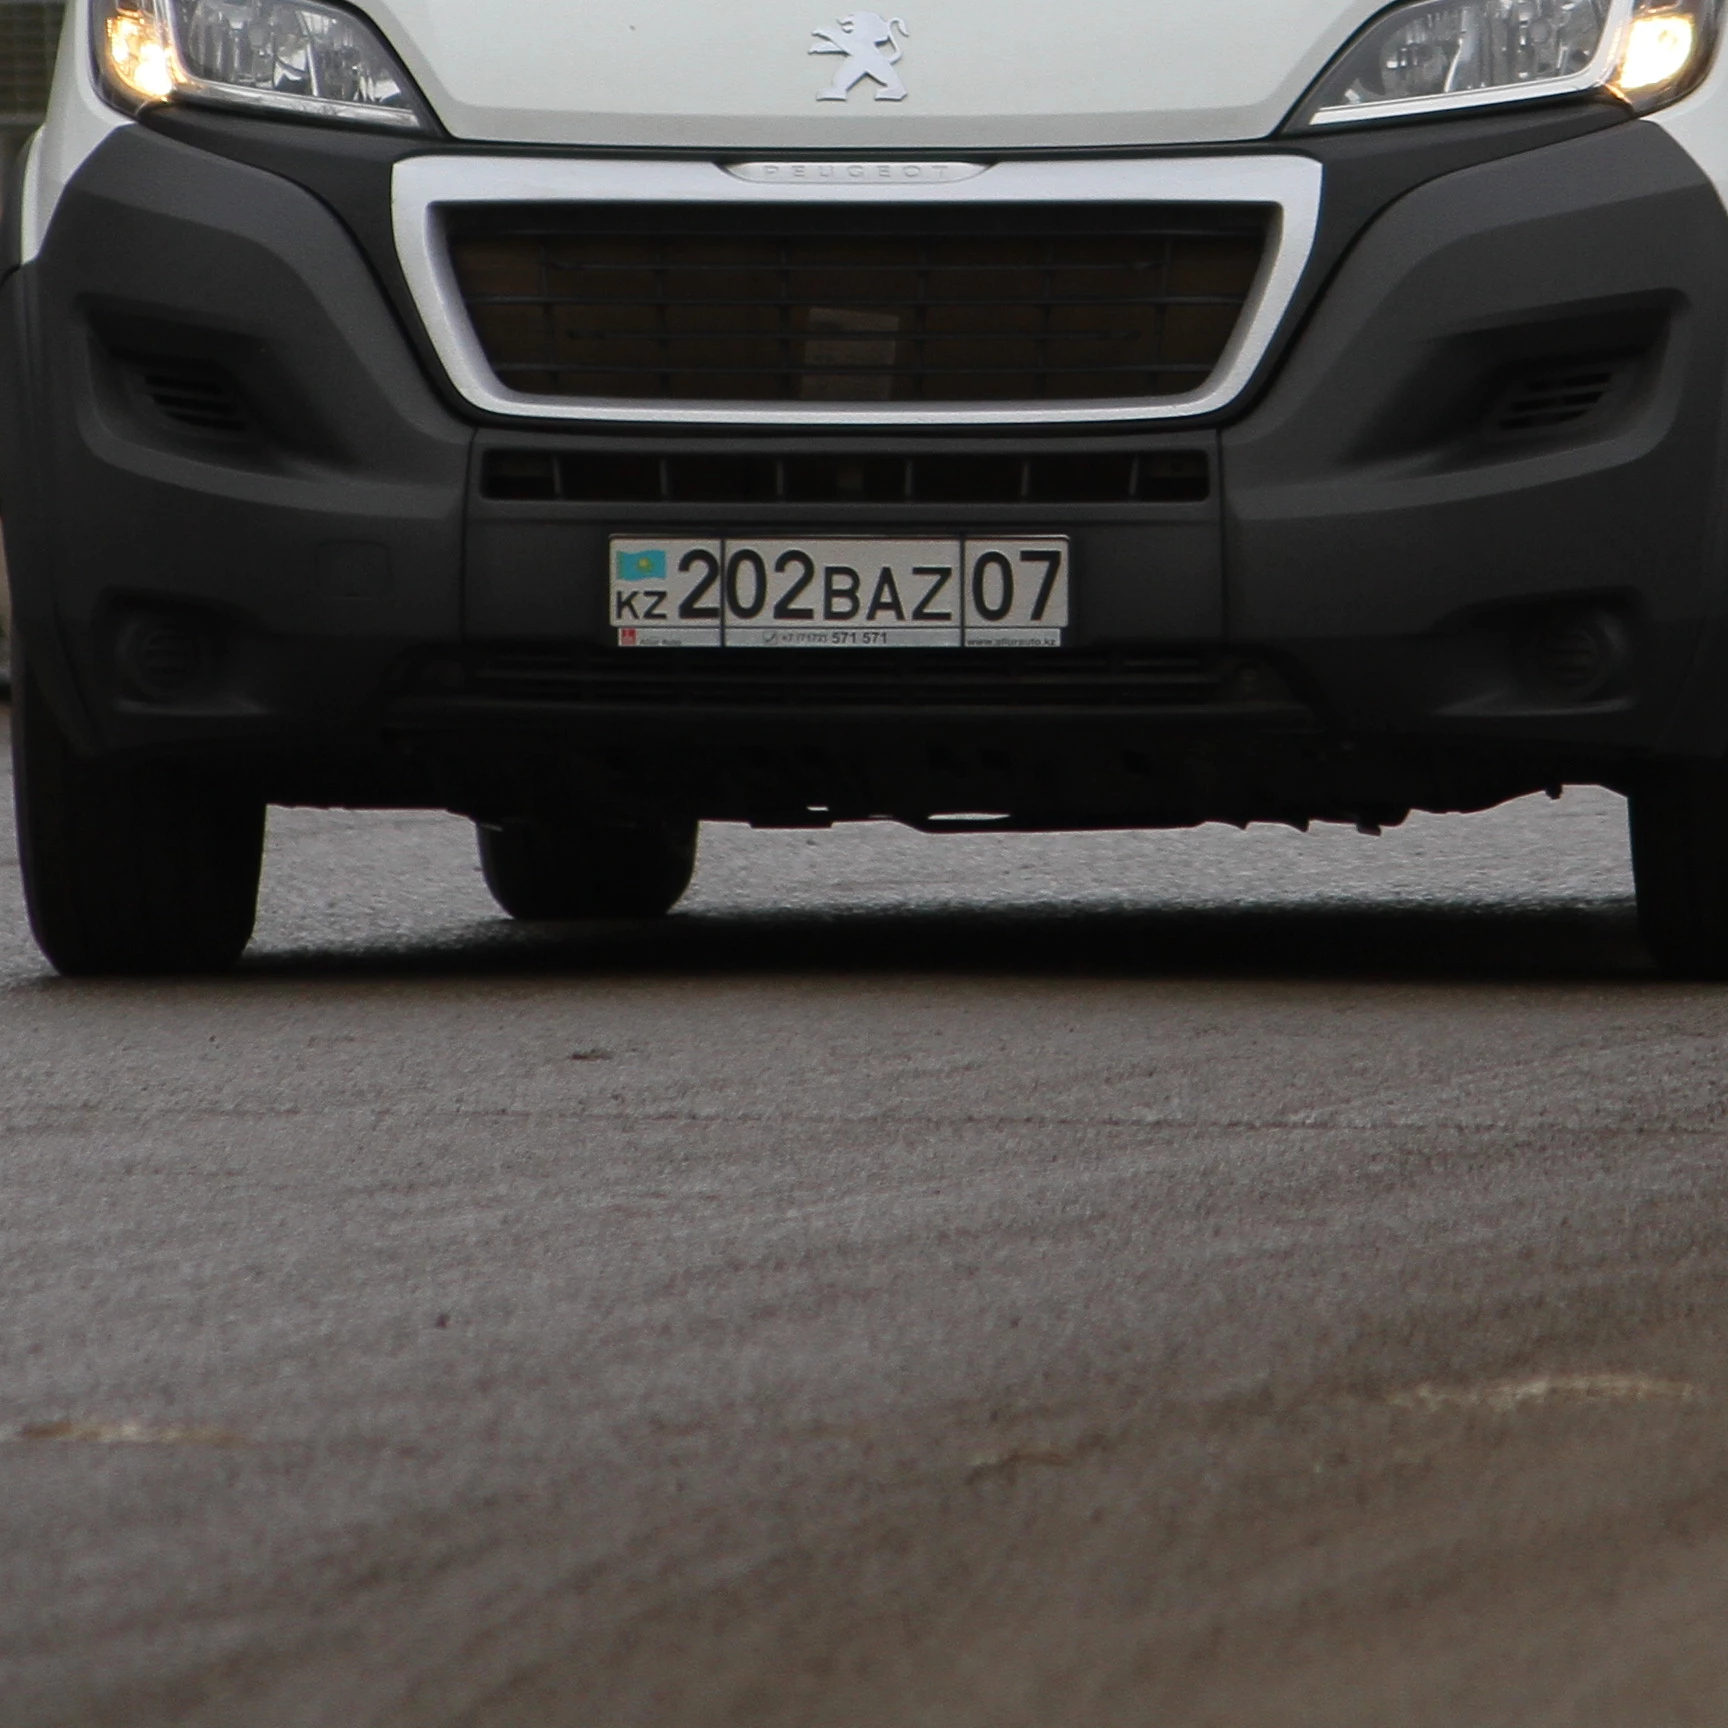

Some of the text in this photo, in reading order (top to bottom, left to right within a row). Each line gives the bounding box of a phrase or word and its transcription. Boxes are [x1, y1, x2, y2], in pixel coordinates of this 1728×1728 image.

[763, 164, 949, 178] PEUGEOT
[615, 548, 1063, 622] KZ 202BAZ 07
[831, 631, 856, 644] 571
[862, 631, 888, 644] 571
